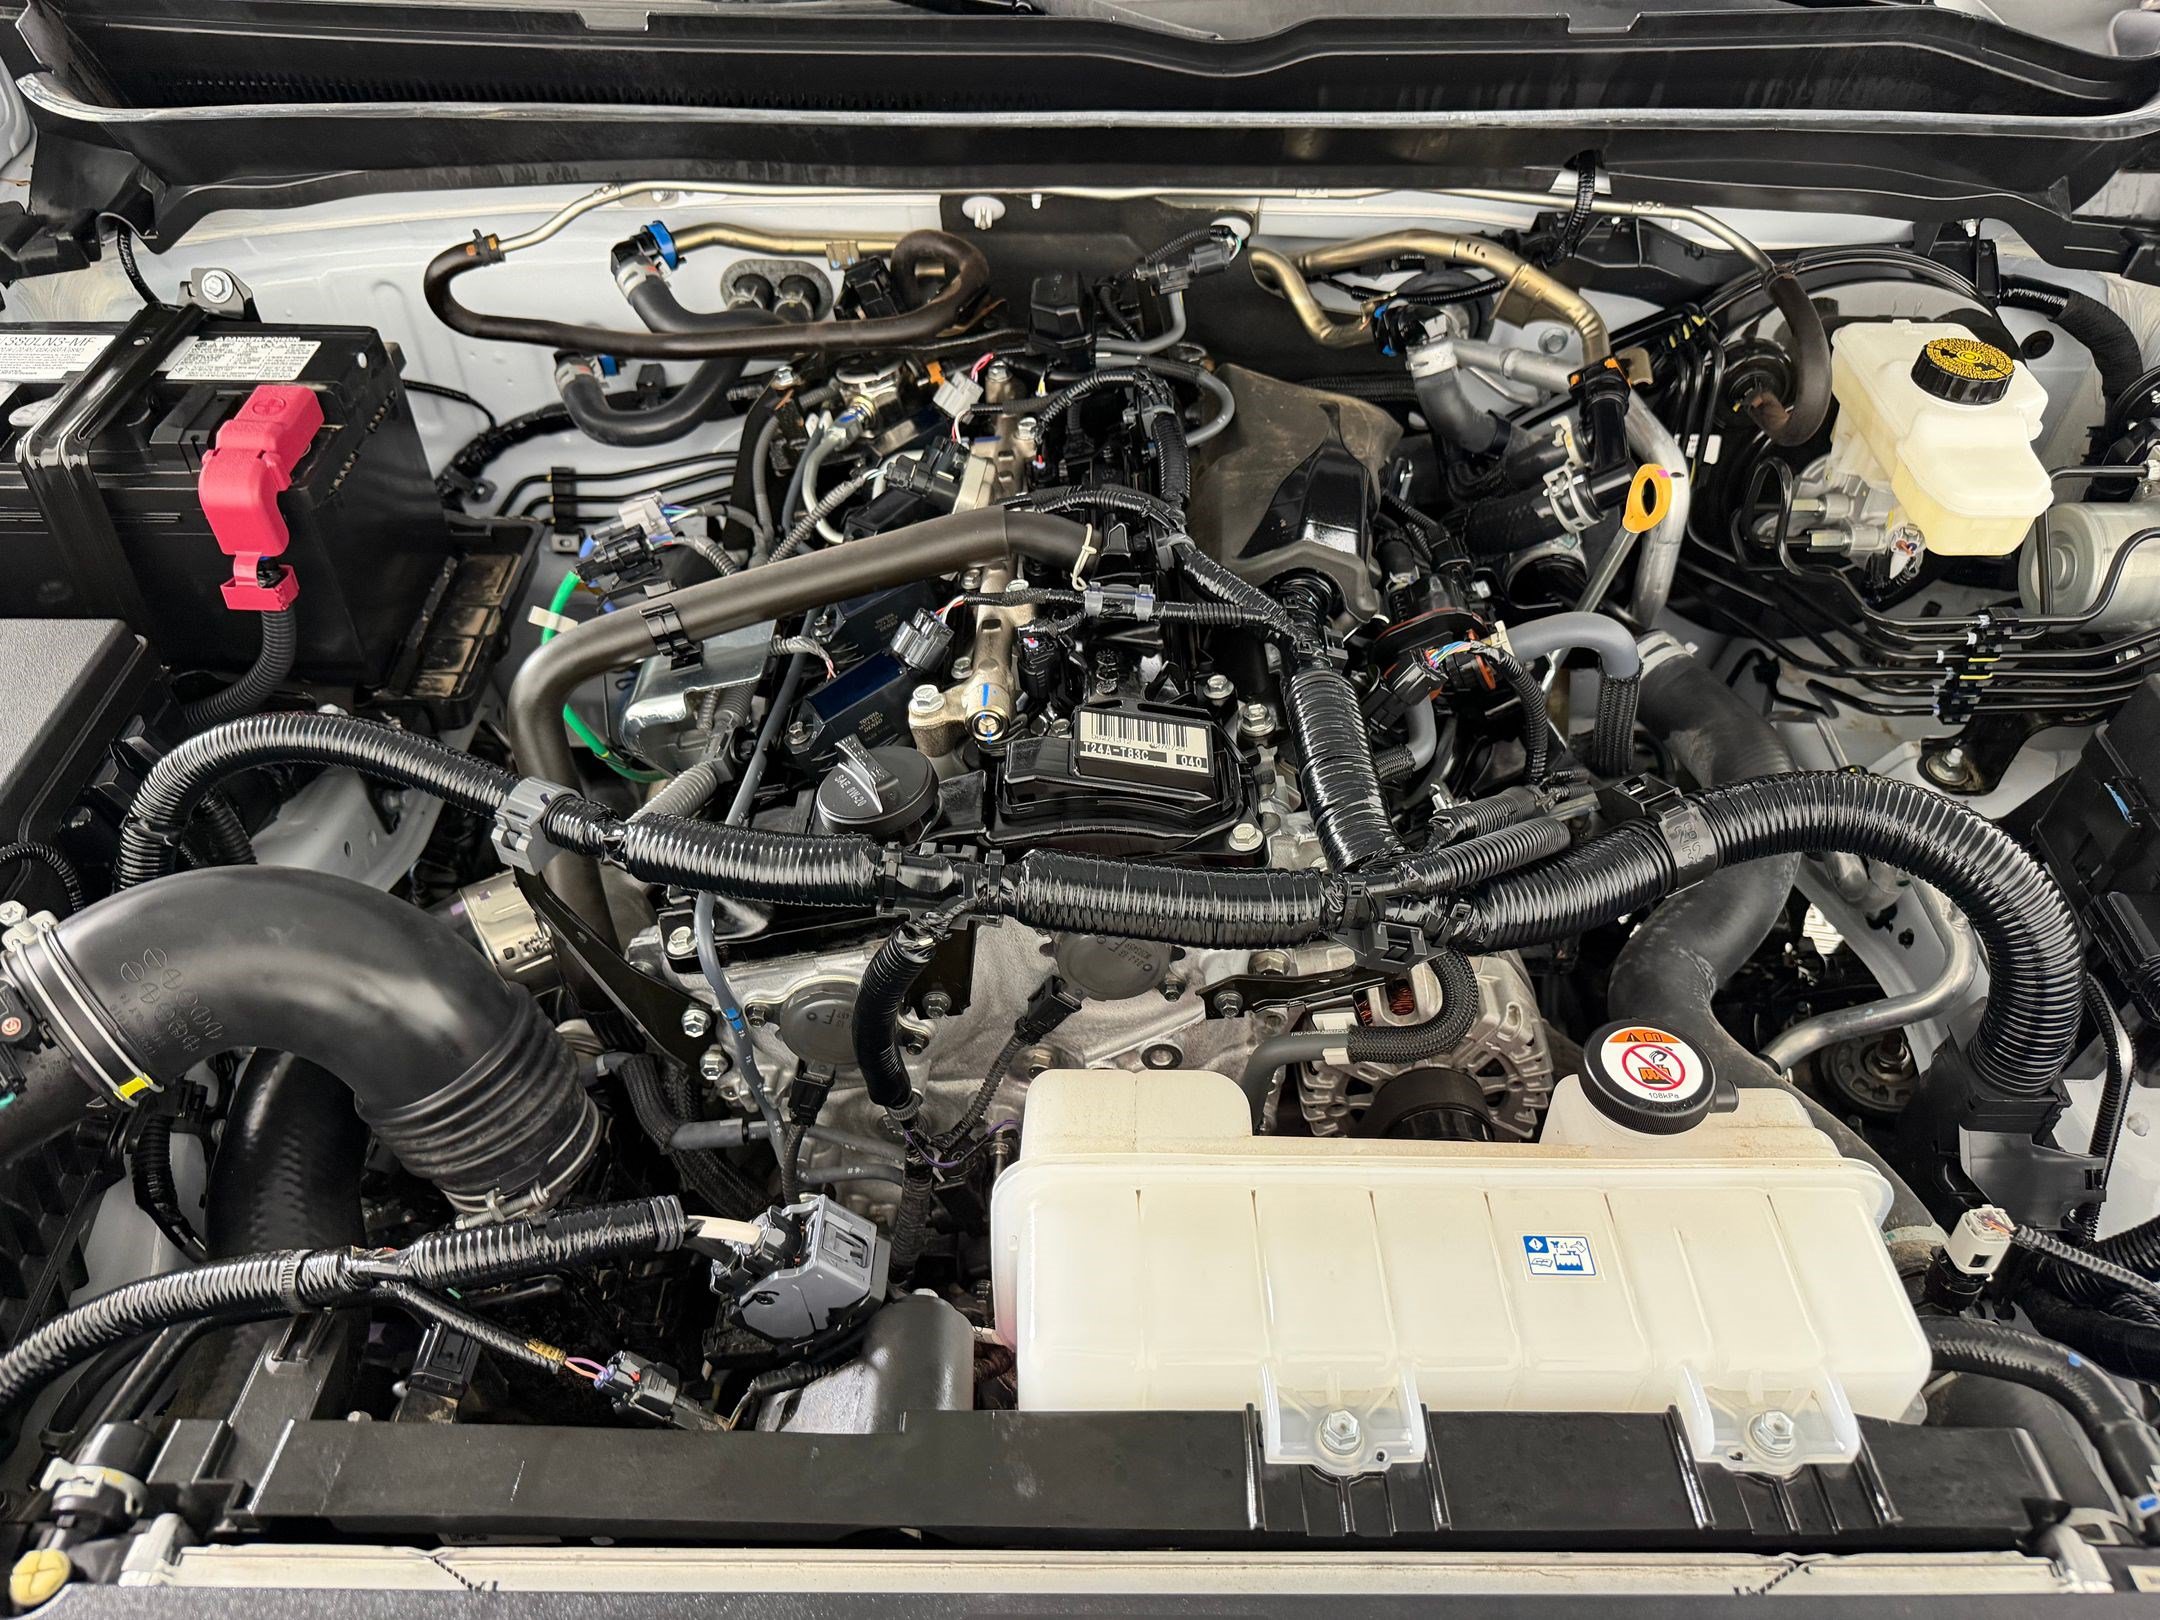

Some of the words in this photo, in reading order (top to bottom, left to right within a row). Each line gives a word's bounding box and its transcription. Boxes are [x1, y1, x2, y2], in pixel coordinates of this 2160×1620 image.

[859, 711, 880, 725] TOYOTA
[864, 719, 883, 733] DENSO
[1083, 741, 1149, 761] T24A-T83C
[1180, 755, 1203, 768] 040
[834, 774, 851, 789] SAE
[846, 786, 867, 807] 0W-20
